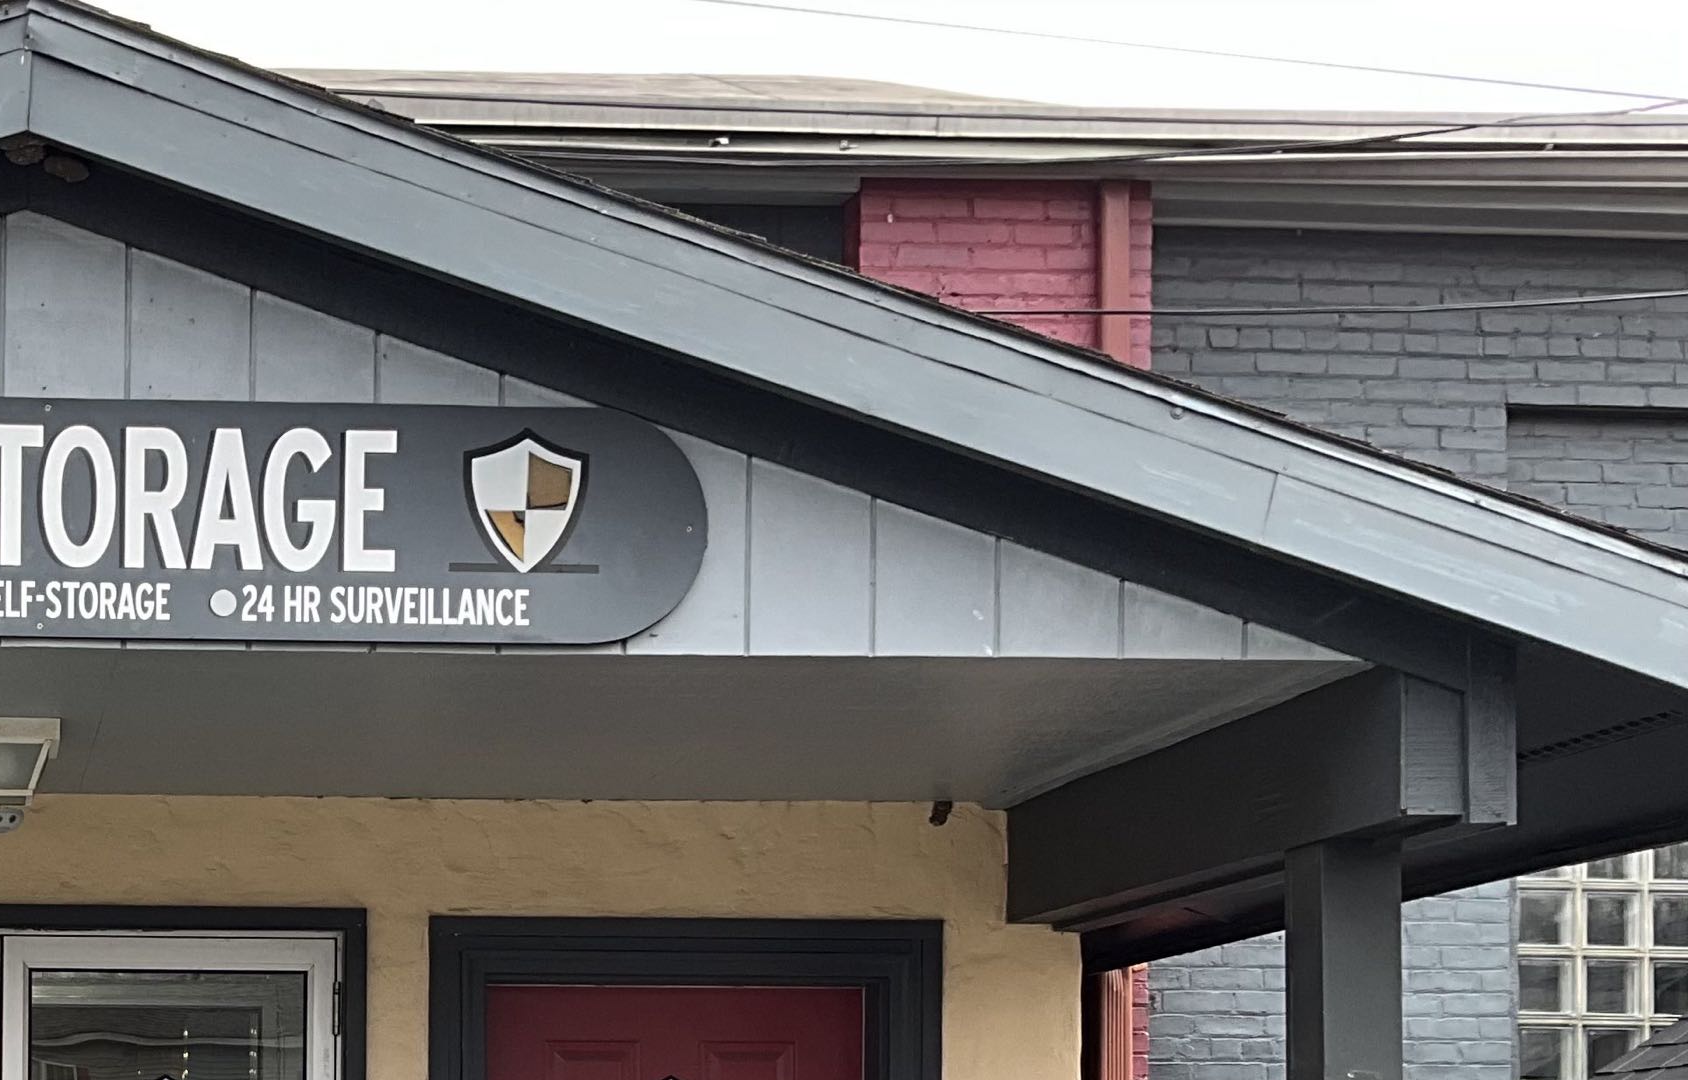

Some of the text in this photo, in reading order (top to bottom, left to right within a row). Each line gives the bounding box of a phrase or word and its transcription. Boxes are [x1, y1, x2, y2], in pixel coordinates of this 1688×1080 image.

[242, 584, 530, 626] 24 HR SURVEILLANCE
